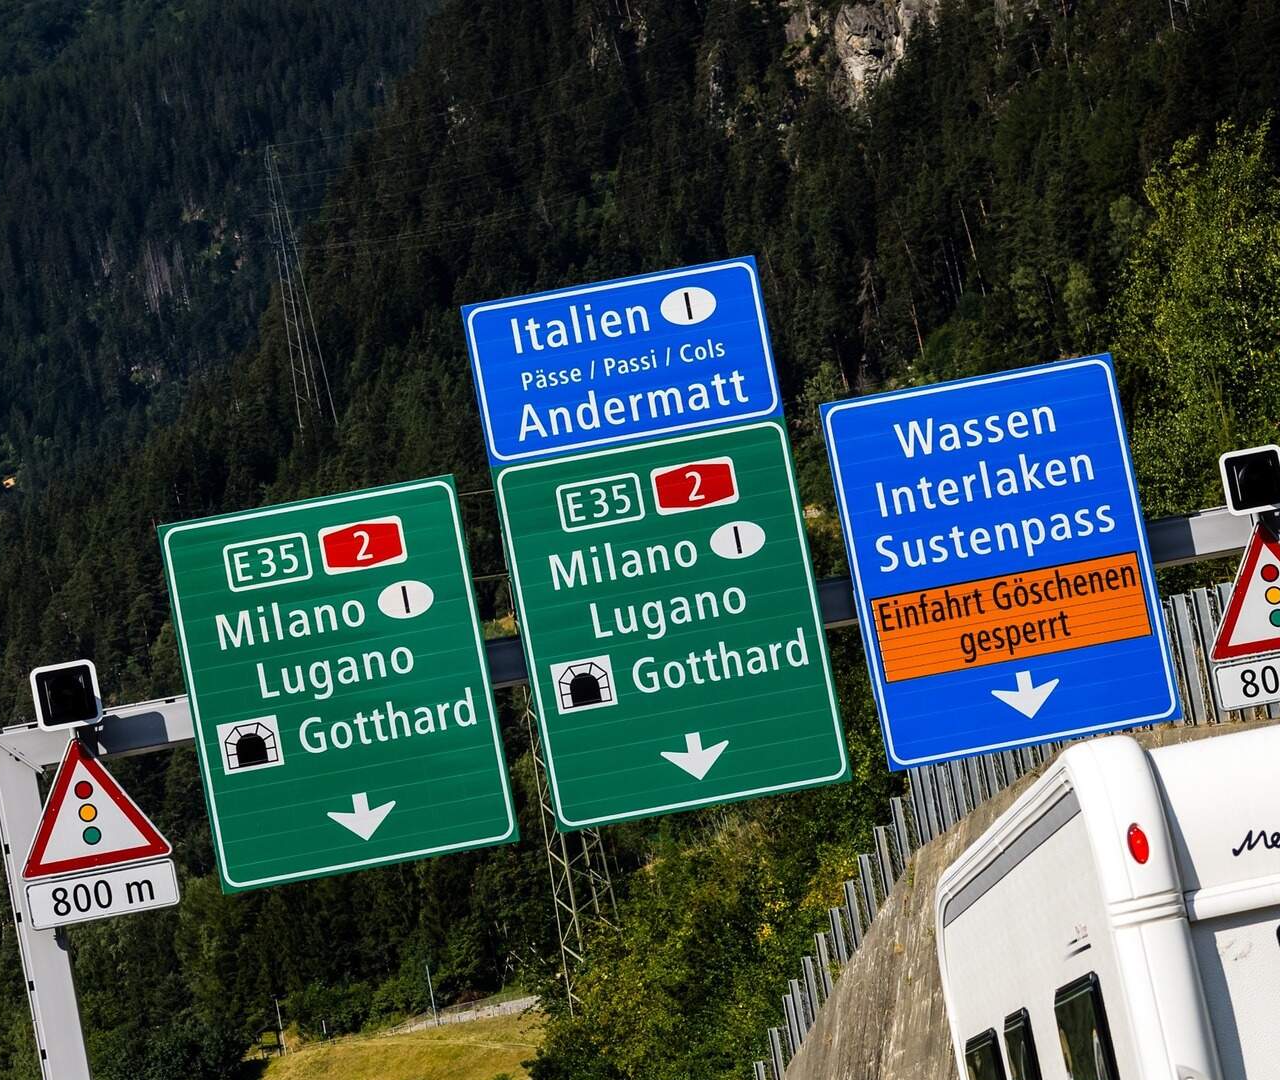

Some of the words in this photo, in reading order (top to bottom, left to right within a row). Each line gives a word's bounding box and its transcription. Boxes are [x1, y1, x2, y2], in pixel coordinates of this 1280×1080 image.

[510, 304, 650, 354] Italien
[684, 292, 694, 320] I
[521, 368, 582, 391] Pässe
[604, 350, 657, 377] Passi
[680, 338, 726, 363] Cols
[518, 369, 749, 442] Andermatt
[893, 404, 1057, 459] Wassen
[566, 484, 632, 523] E35
[684, 472, 705, 502] 2
[875, 452, 1095, 518] Interlaken
[234, 543, 299, 583] E35
[352, 531, 374, 562] 2
[548, 540, 698, 591] Milano
[733, 526, 743, 555] I
[875, 504, 1117, 574] Sustenpass
[215, 600, 366, 651] Milano
[401, 586, 411, 614] I
[589, 587, 747, 640] Lugano
[878, 589, 985, 633] Einfahrt
[992, 563, 1137, 609] Göschenen
[632, 628, 810, 694] Gotthard
[960, 610, 1071, 663] gesperrt
[256, 647, 415, 701] Lugano
[299, 687, 478, 755] Gotthard
[51, 879, 113, 917] 800
[126, 878, 156, 905] m
